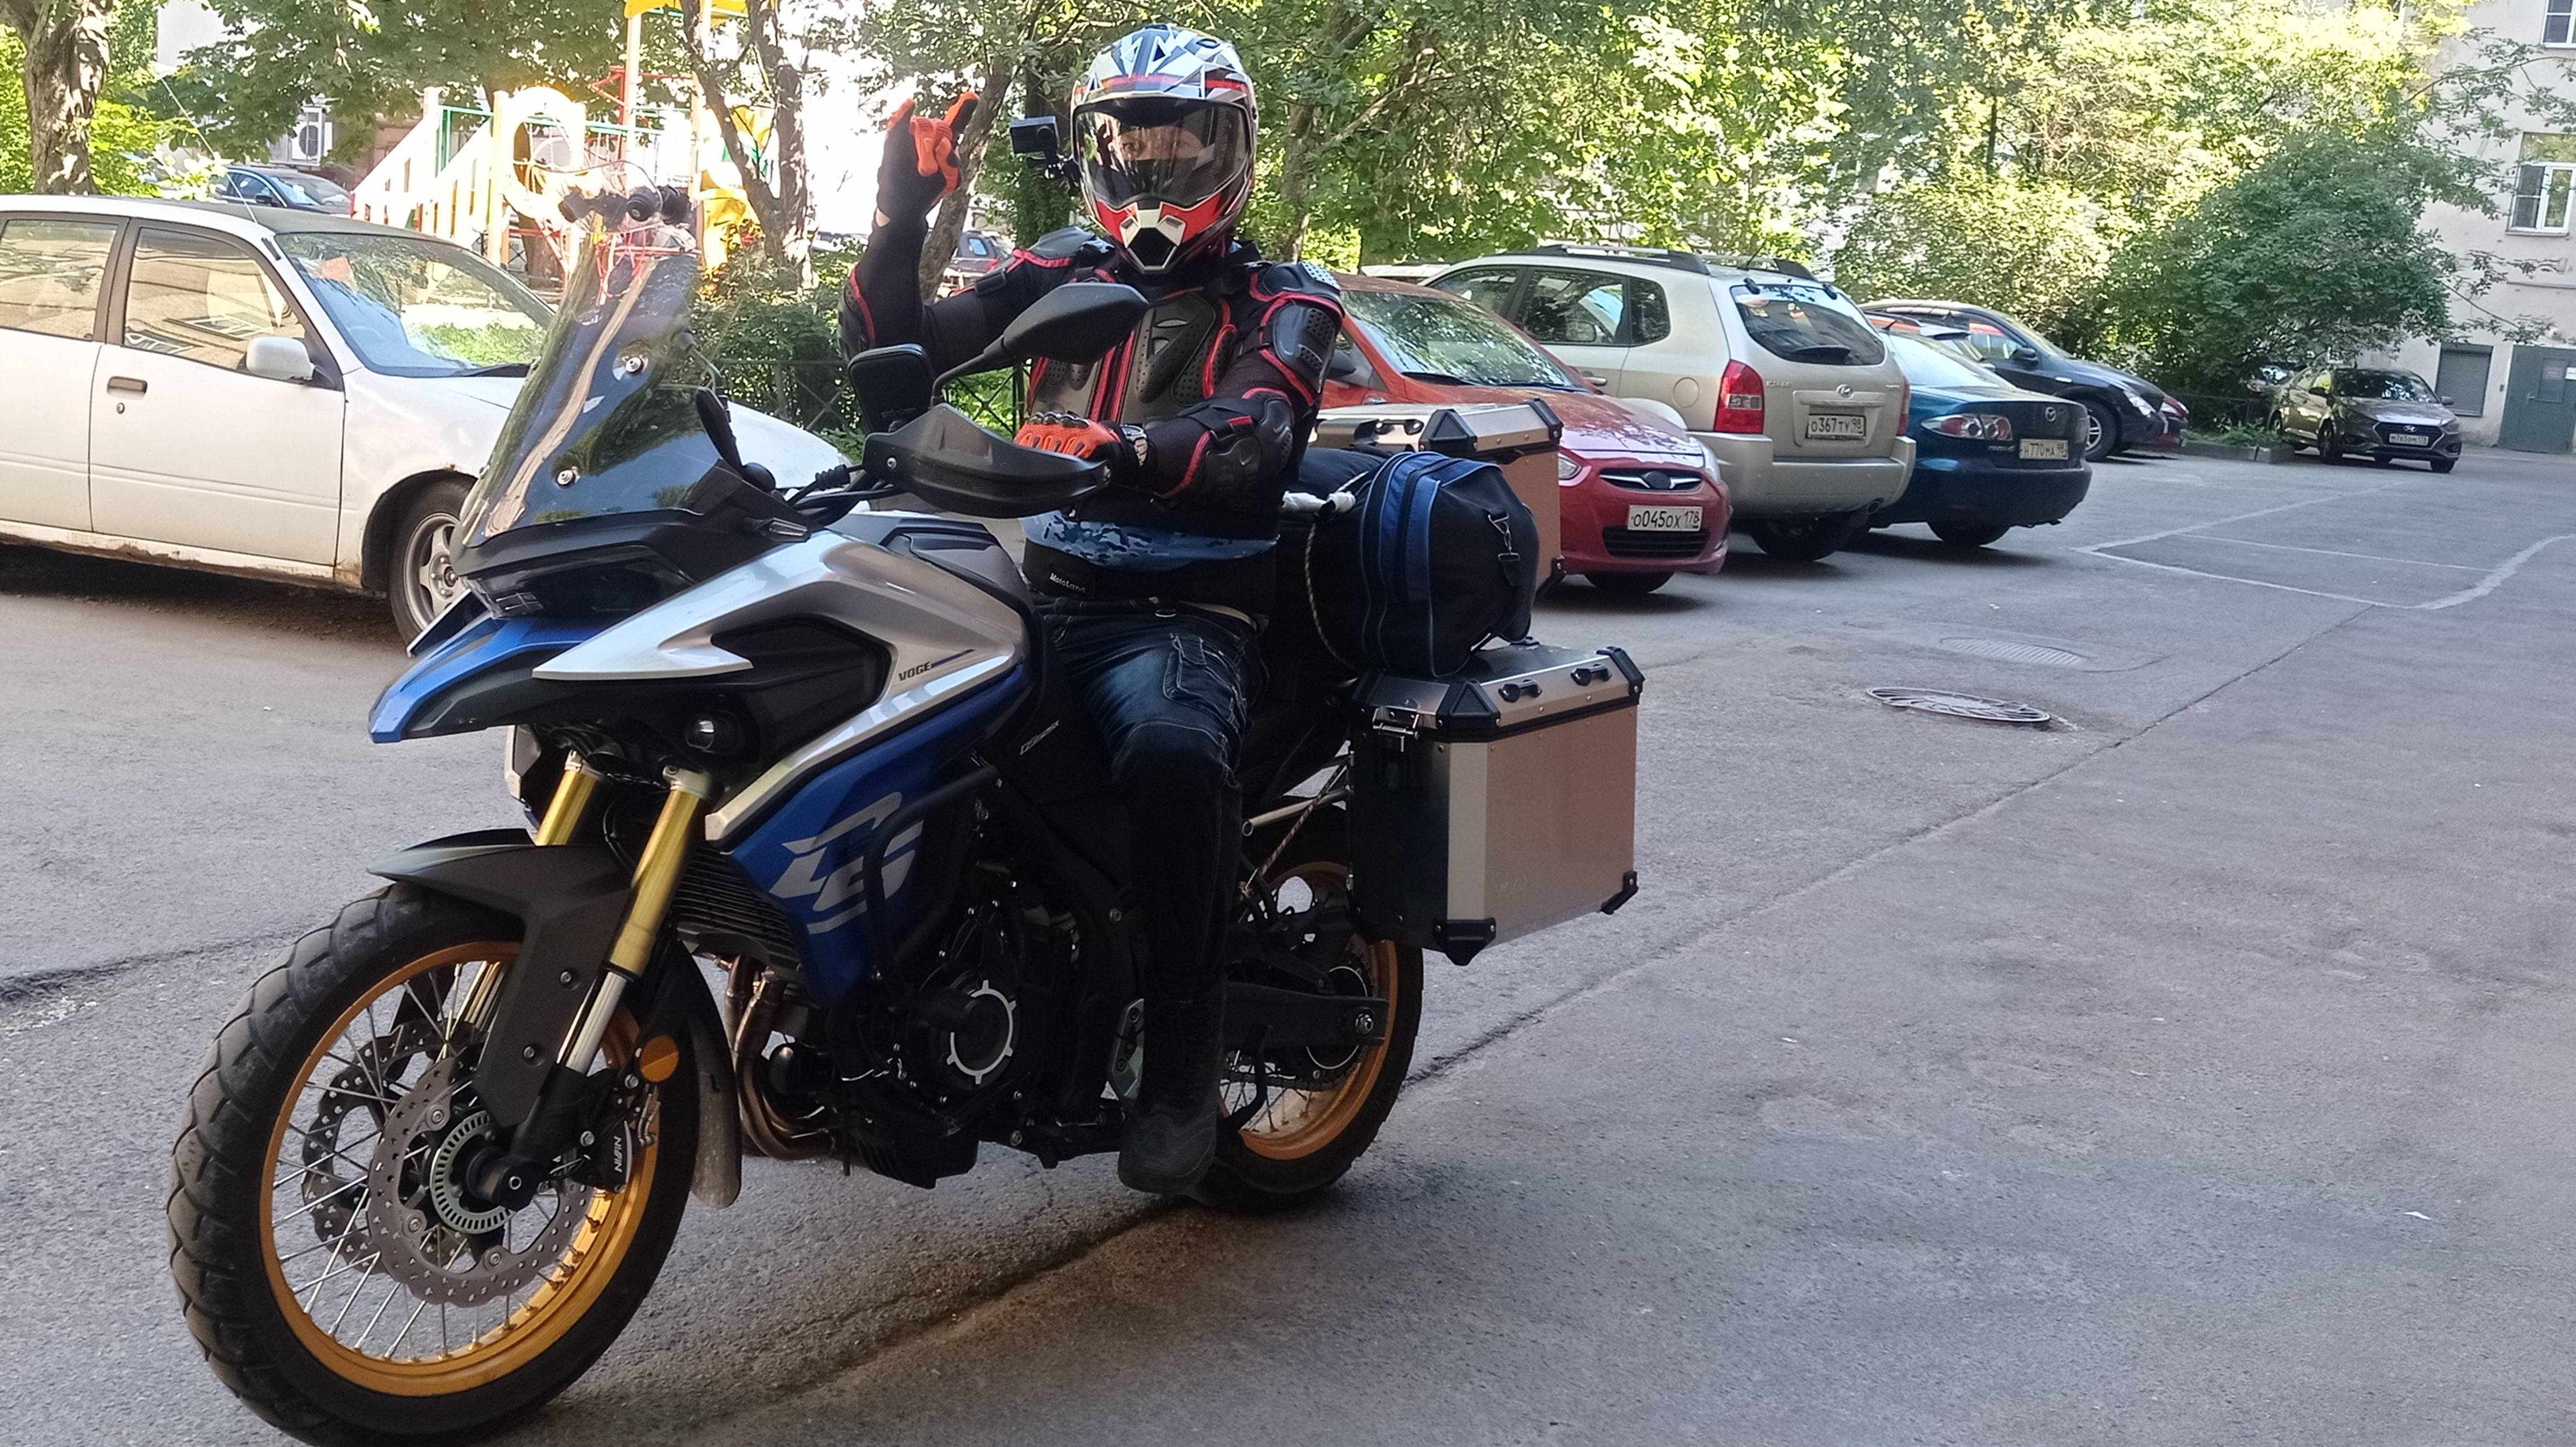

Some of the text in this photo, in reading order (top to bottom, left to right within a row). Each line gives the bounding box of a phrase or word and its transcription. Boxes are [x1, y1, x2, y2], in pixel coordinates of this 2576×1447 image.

[1633, 510, 1700, 527] О045ОХ 178
[898, 661, 932, 681] VOGE
